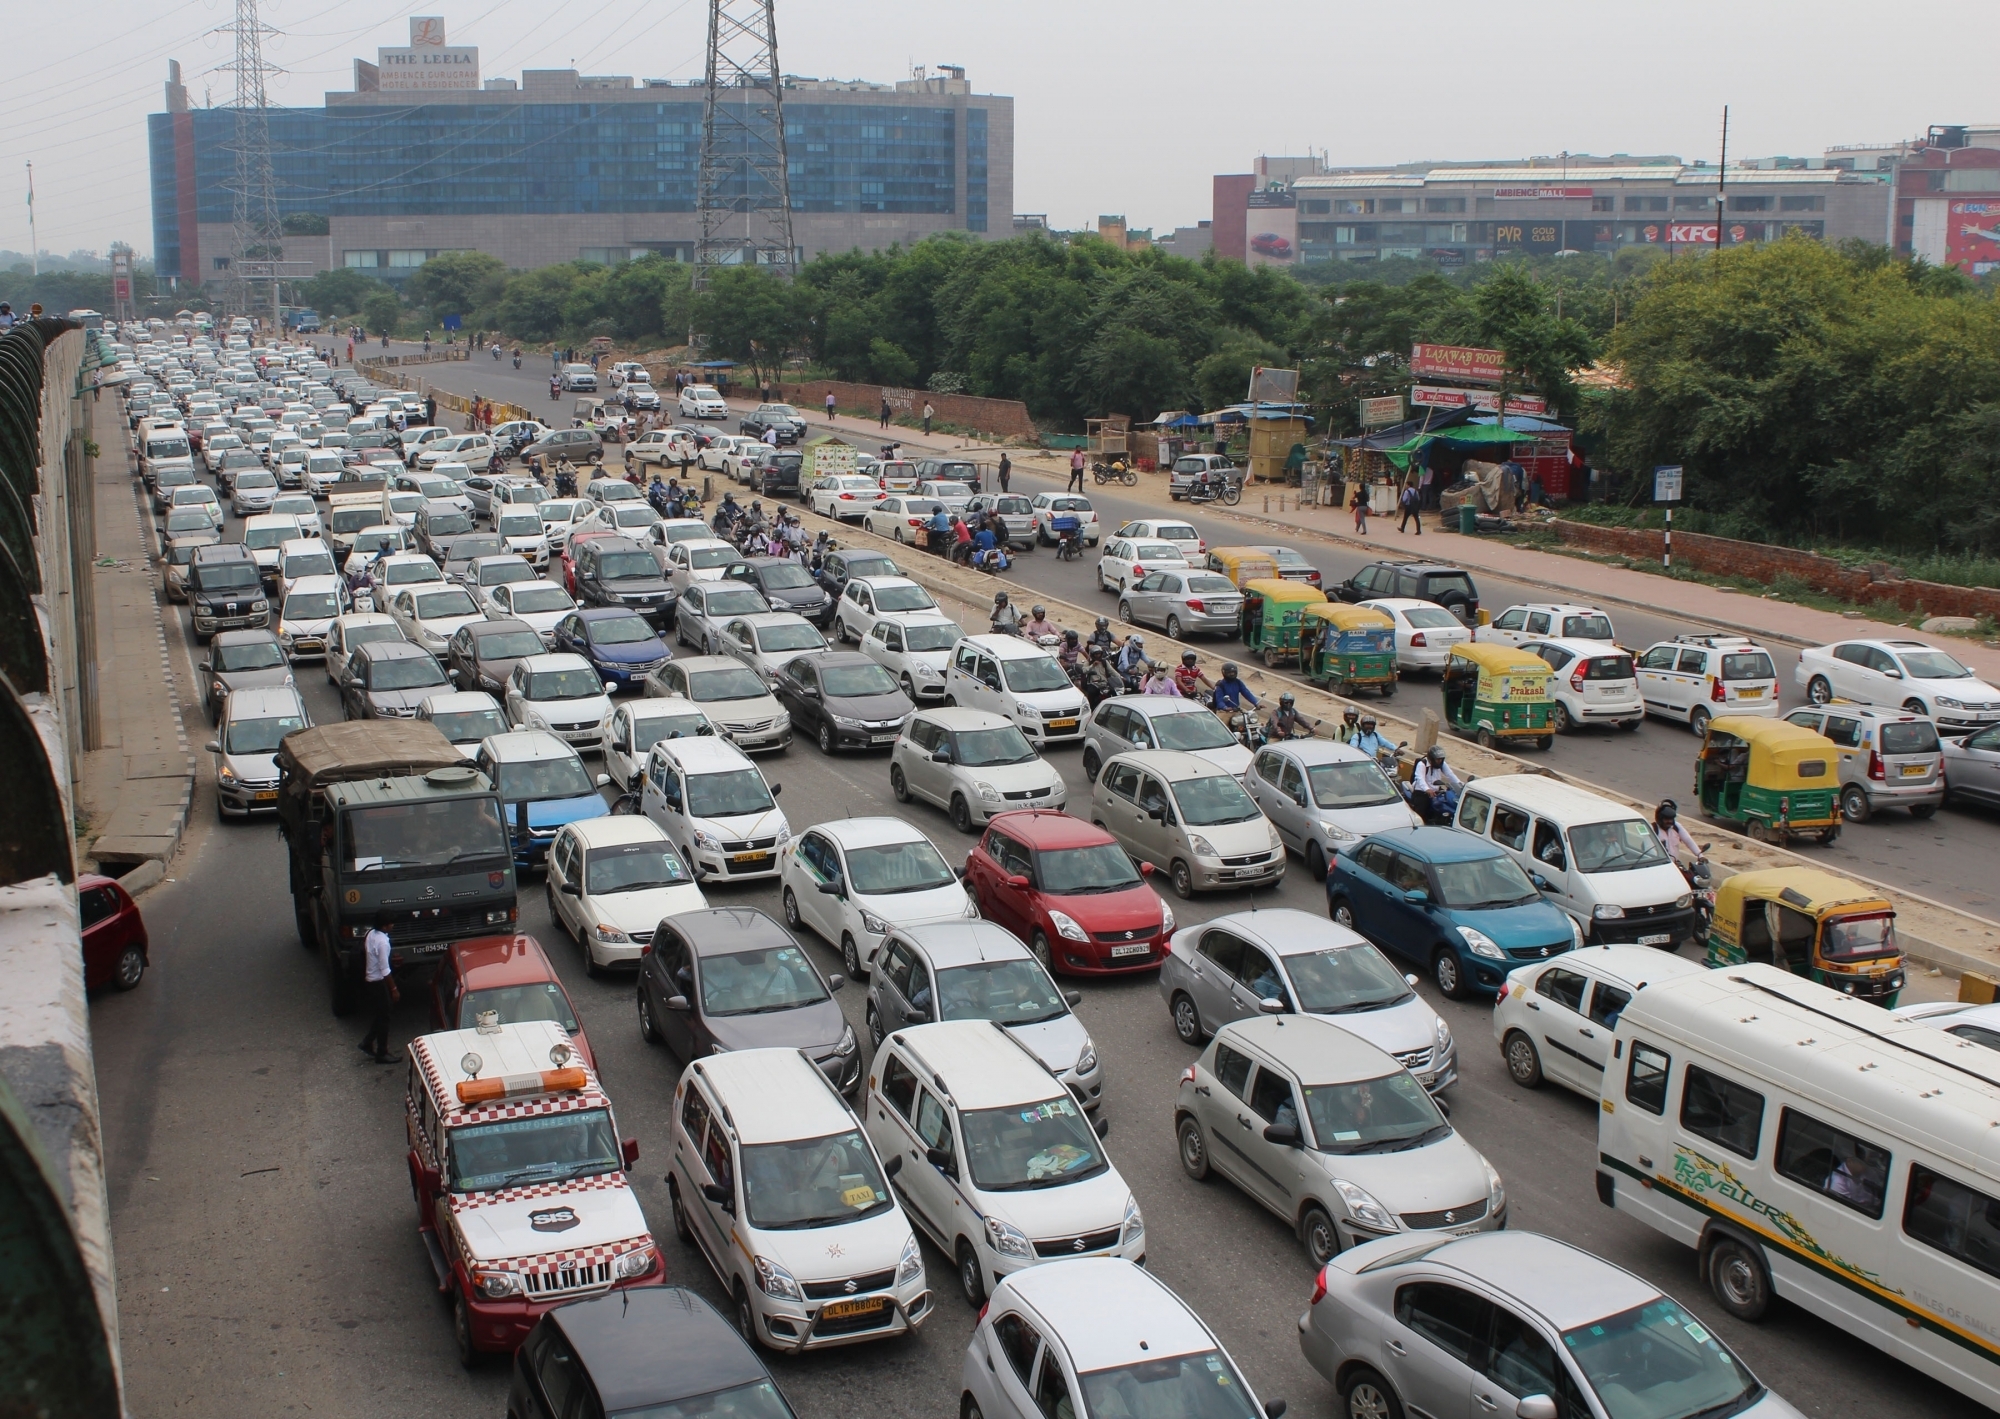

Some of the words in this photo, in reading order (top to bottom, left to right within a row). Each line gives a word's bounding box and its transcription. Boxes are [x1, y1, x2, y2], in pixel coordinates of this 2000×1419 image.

[385, 54, 417, 65] THE
[423, 54, 471, 64] LEELA
[381, 71, 425, 79] AMBIENCE
[428, 70, 478, 79] GURUGRAM
[382, 81, 410, 89] HOTEL
[422, 80, 476, 88] RESIDENCES
[1495, 188, 1538, 197] AMBIENCE
[1540, 189, 1564, 197] MALL
[1497, 226, 1522, 242] PVR
[1532, 227, 1555, 235] GOLD
[1668, 226, 1718, 242] KFC
[1425, 348, 1472, 366] LAJAWAB
[1475, 352, 1505, 365] FOOD
[1510, 686, 1545, 695] Prakash
[349, 891, 357, 903] 8
[463, 1126, 500, 1137] QUICK
[504, 1118, 563, 1132] RESPONSE
[475, 1175, 500, 1185] GAIL
[1675, 1172, 1705, 1193] CNG
[1673, 1153, 1781, 1221] TRAVELLER
[850, 1190, 871, 1203] TAXI
[533, 1210, 575, 1225] SIS
[1913, 1290, 1945, 1313] MILES
[1947, 1307, 1961, 1318] OF
[1964, 1315, 2000, 1339] SMILE
